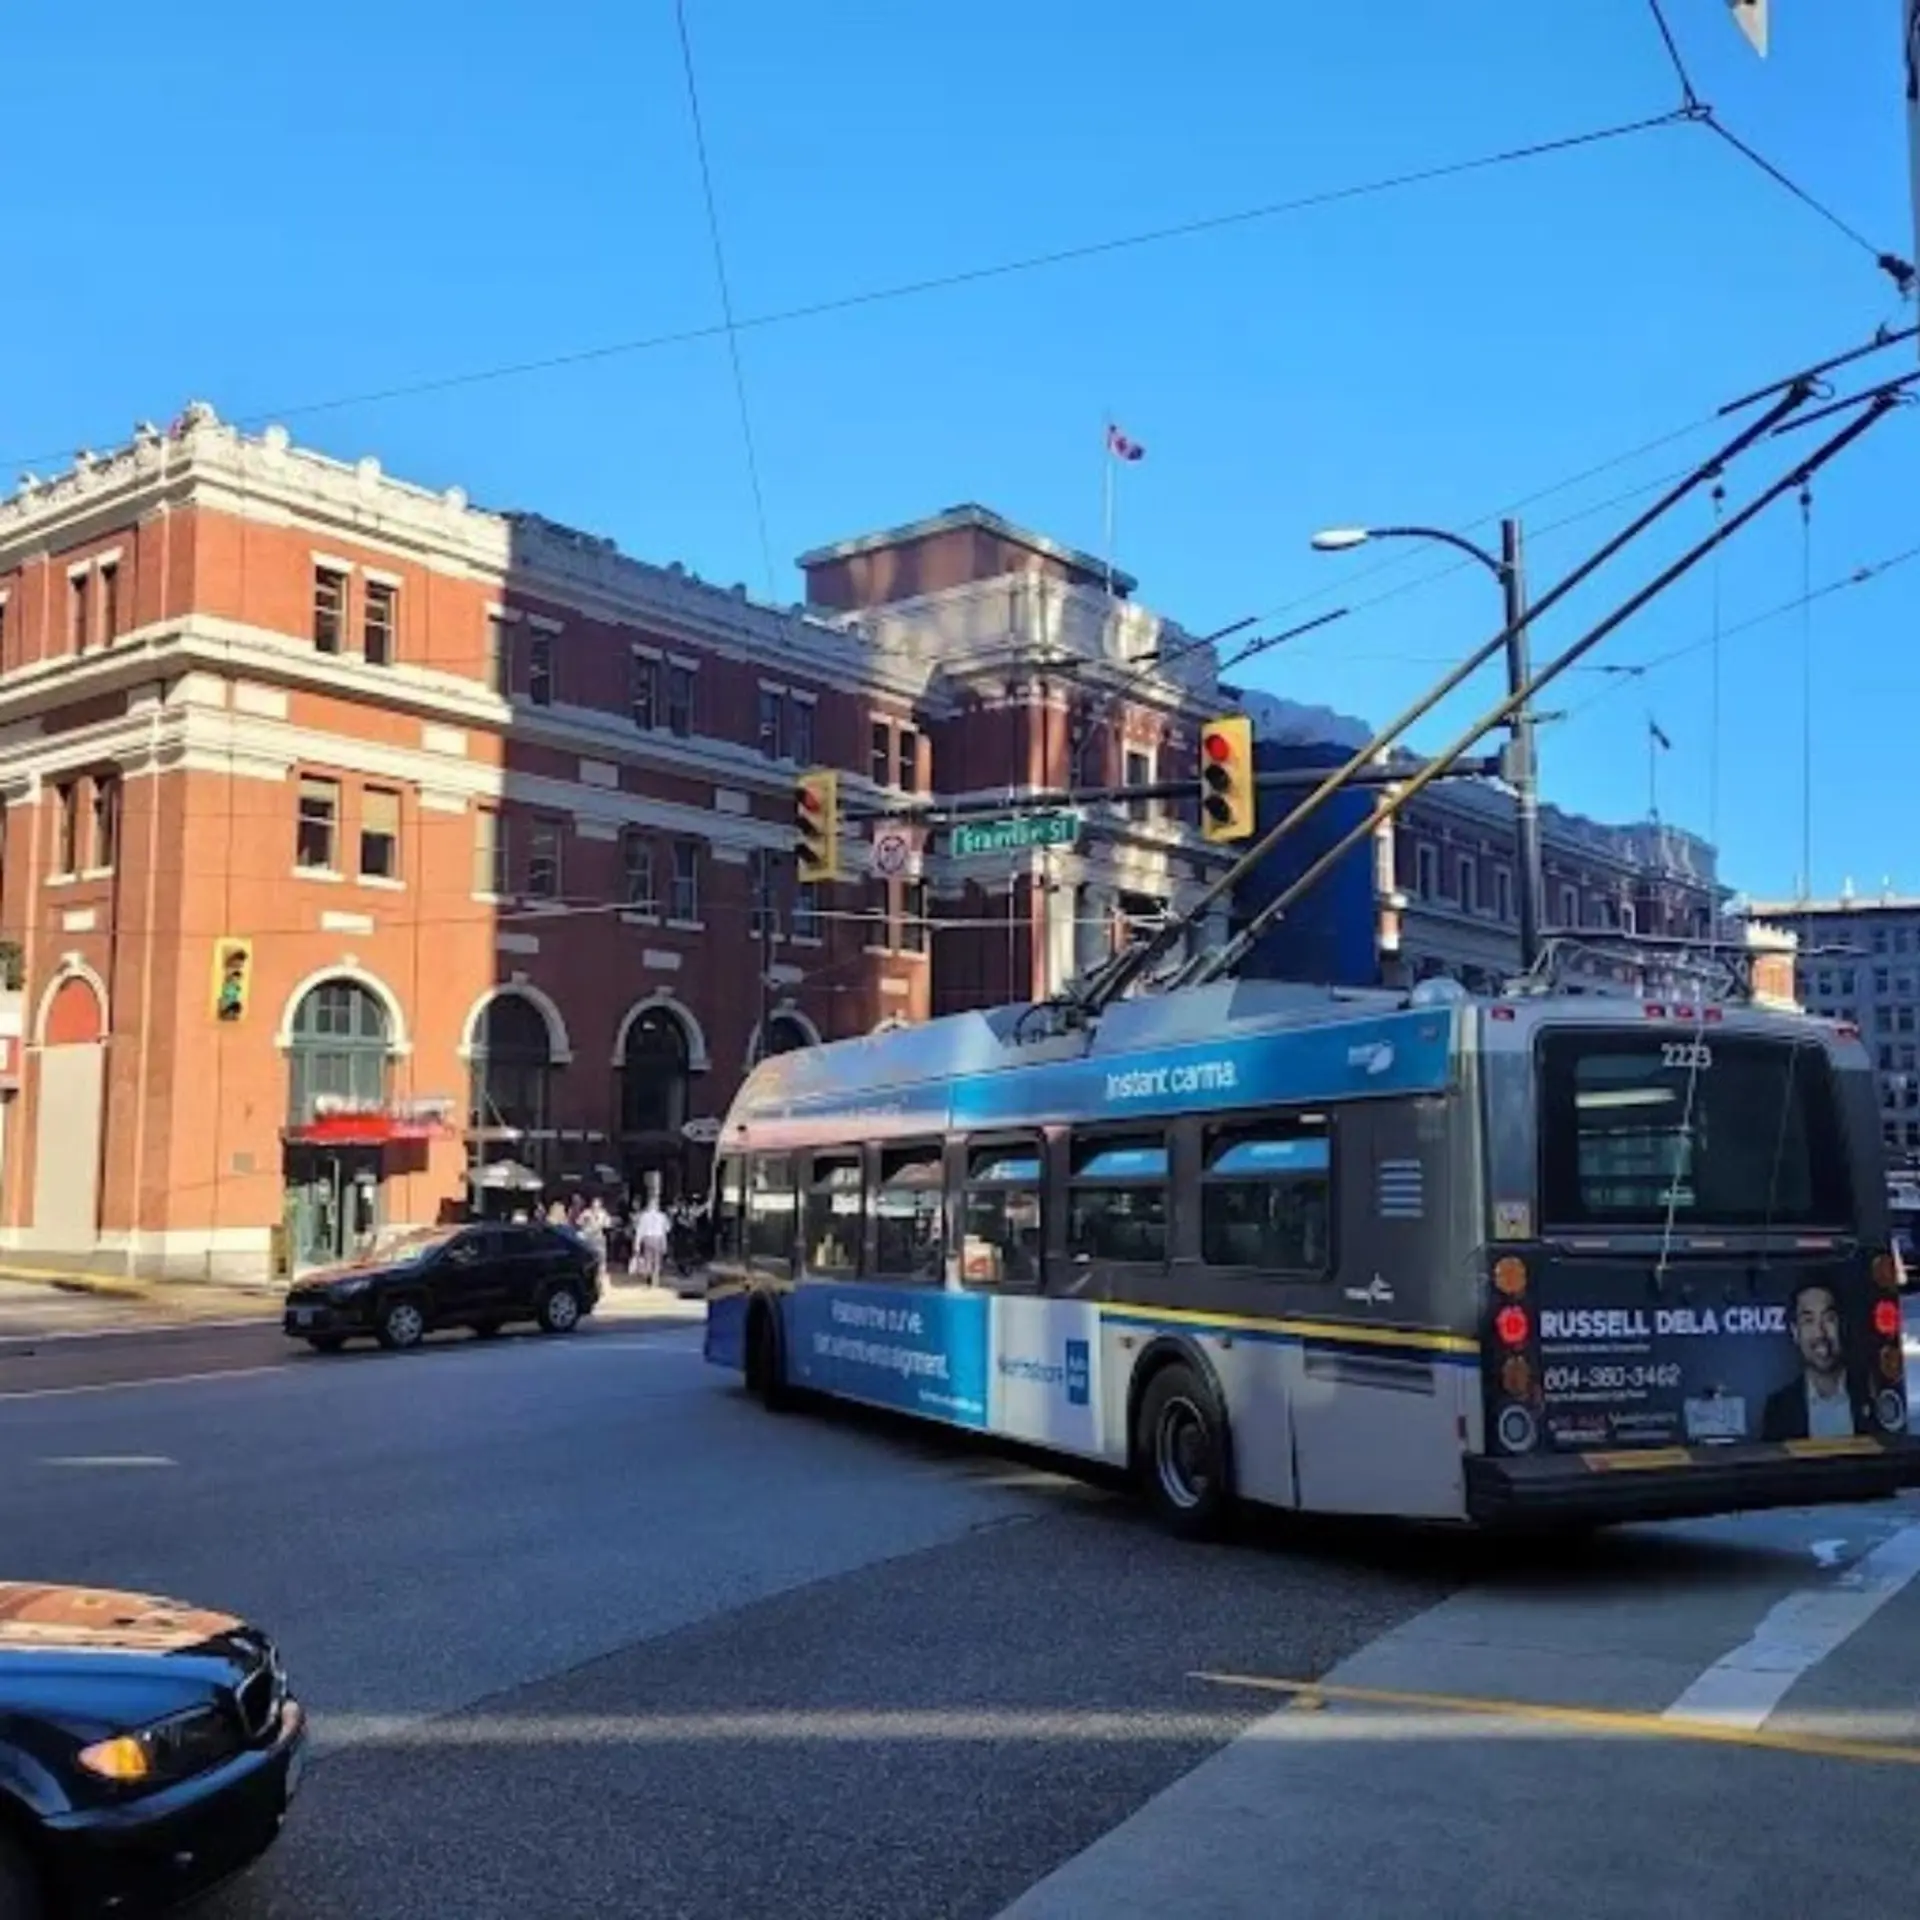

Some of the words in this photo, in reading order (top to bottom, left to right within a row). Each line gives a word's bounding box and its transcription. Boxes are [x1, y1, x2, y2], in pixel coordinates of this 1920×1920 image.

[1540, 1309, 1650, 1338] RUSSELL
[1653, 1308, 1720, 1335] DELA
[1723, 1306, 1787, 1332] CRUZ
